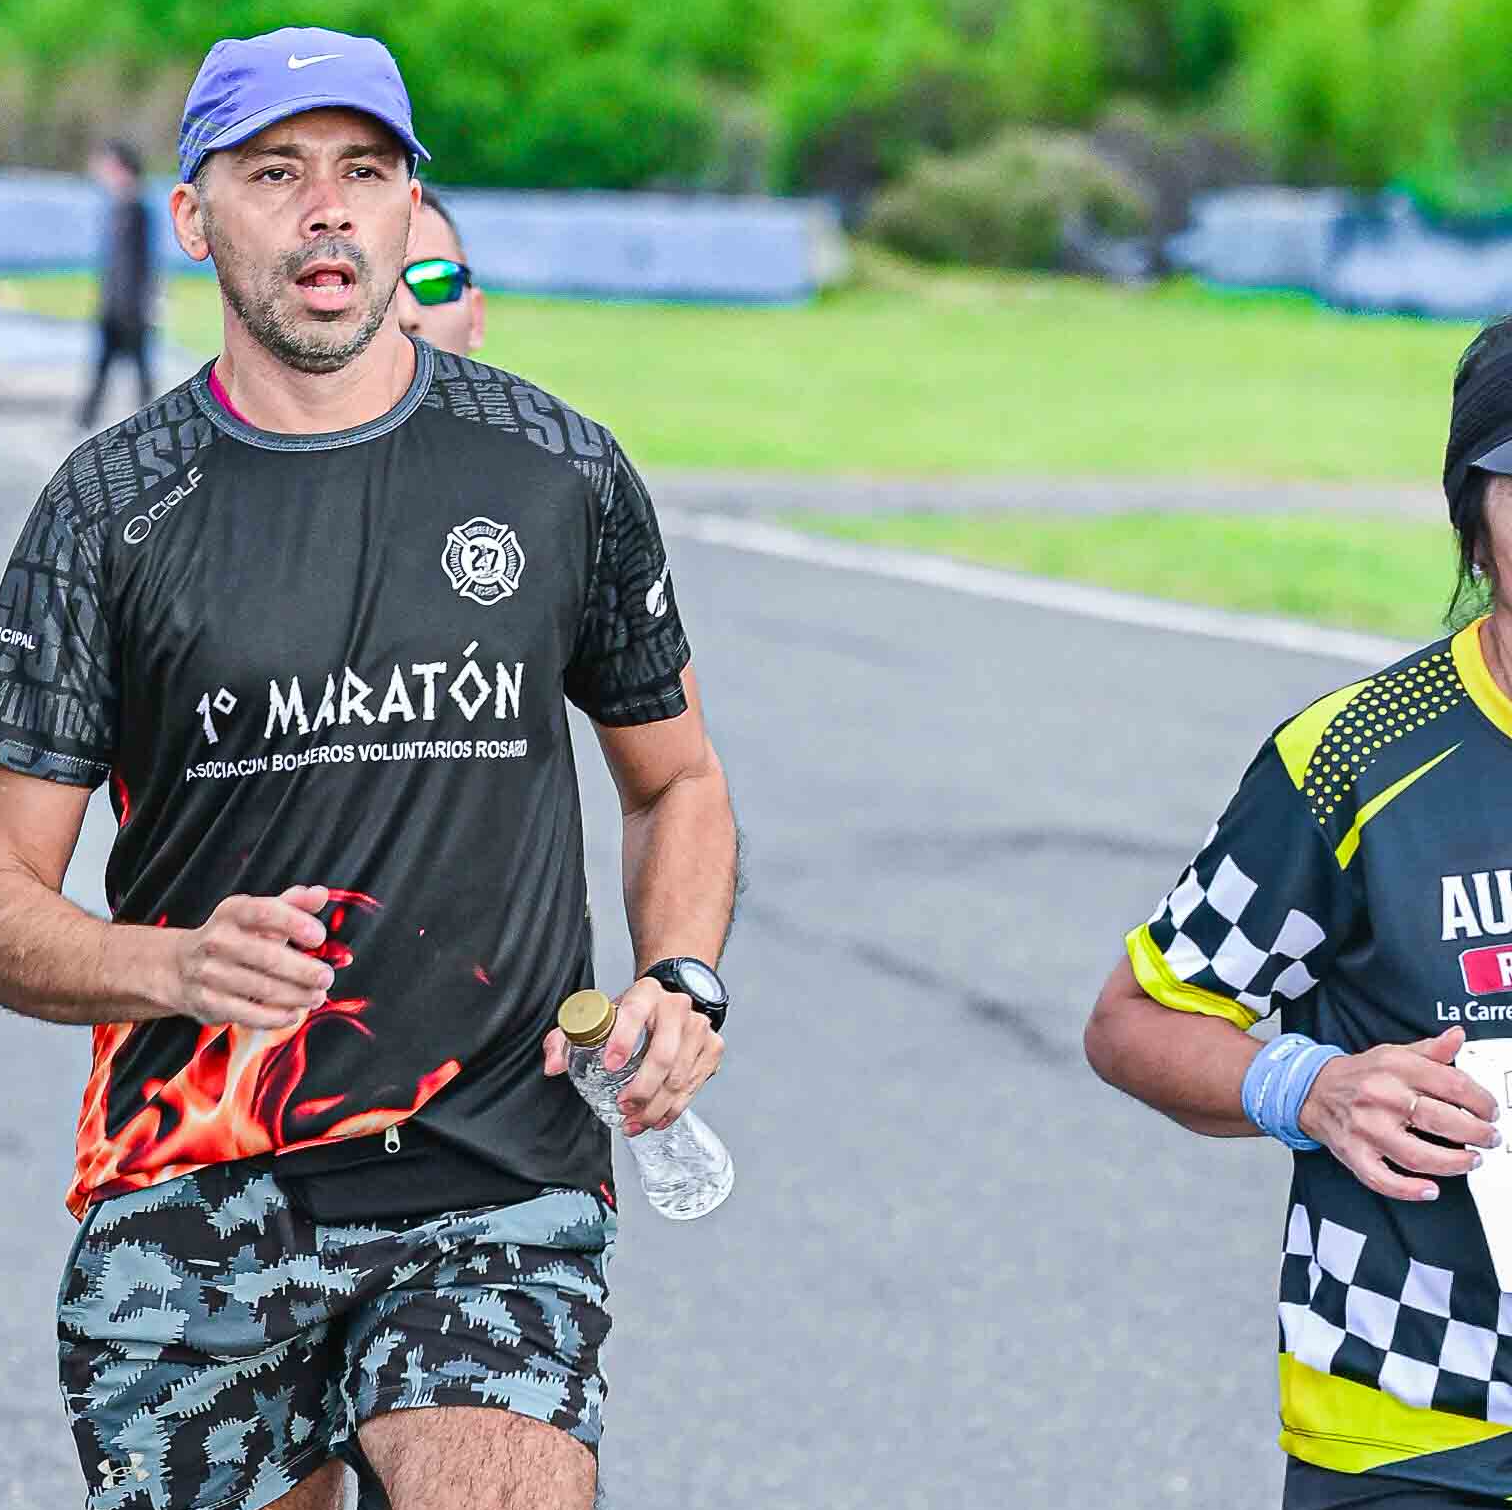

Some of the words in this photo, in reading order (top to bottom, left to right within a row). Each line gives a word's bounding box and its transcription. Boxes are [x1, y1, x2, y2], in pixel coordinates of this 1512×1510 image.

[469, 544, 499, 572] 27
[263, 640, 525, 740] MARATÓN
[357, 740, 473, 762] VOLUNTARIOS
[1436, 1001, 1461, 1021] La
